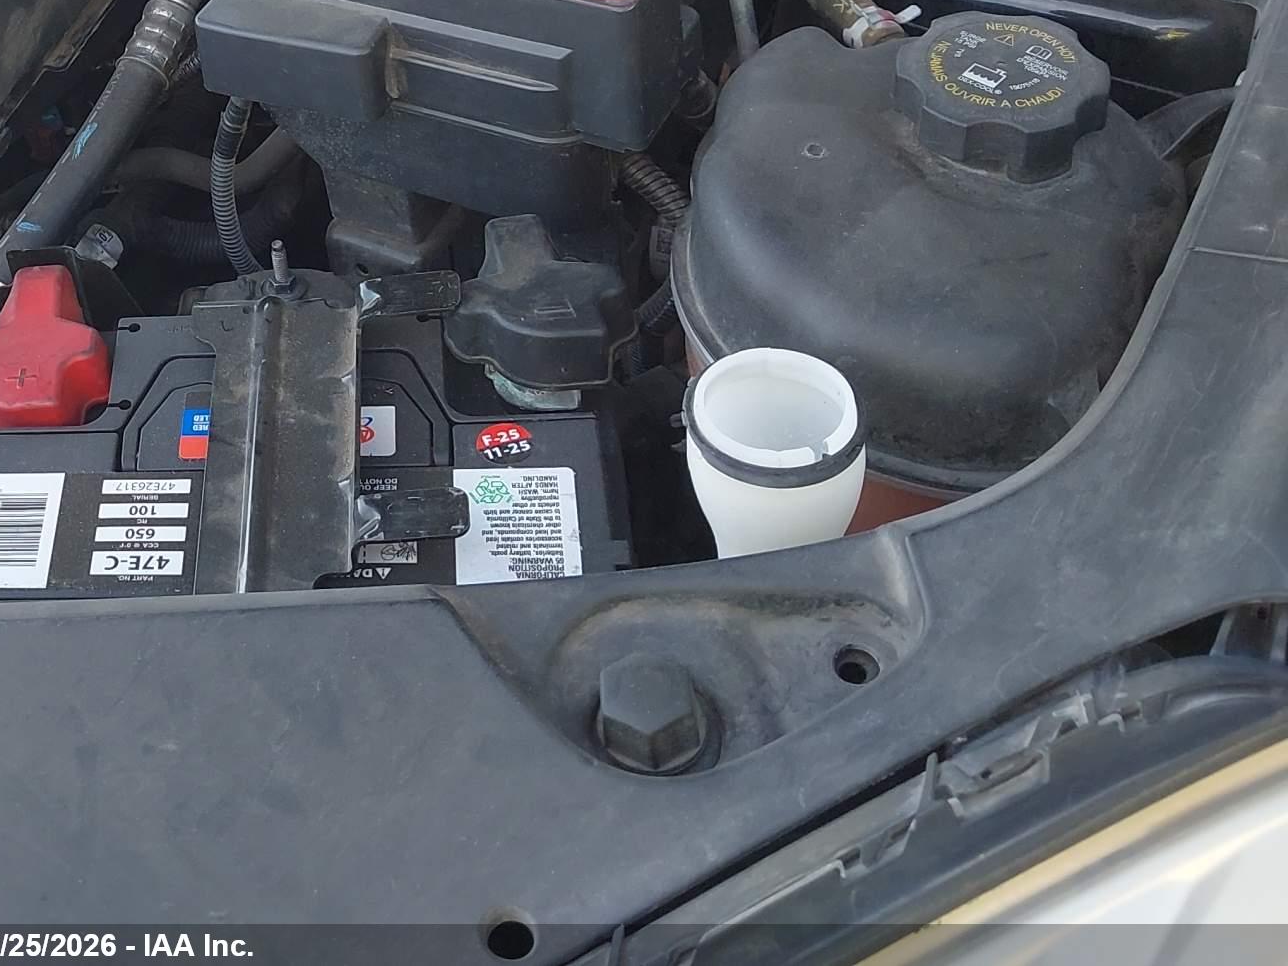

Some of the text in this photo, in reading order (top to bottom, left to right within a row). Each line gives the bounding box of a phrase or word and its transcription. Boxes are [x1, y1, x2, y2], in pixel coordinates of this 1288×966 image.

[986, 22, 1076, 62] NEVER OPEN HOT!
[933, 40, 952, 53] NE
[944, 83, 996, 106] OUVRIR
[1000, 99, 1012, 108] A
[1014, 86, 1065, 107] CHAUD!
[482, 428, 520, 446] F-25
[484, 440, 531, 460] 11-25
[116, 482, 176, 491] 47E26317
[129, 506, 157, 515] 100
[125, 529, 155, 539] 650
[104, 556, 170, 570] 47E-C
